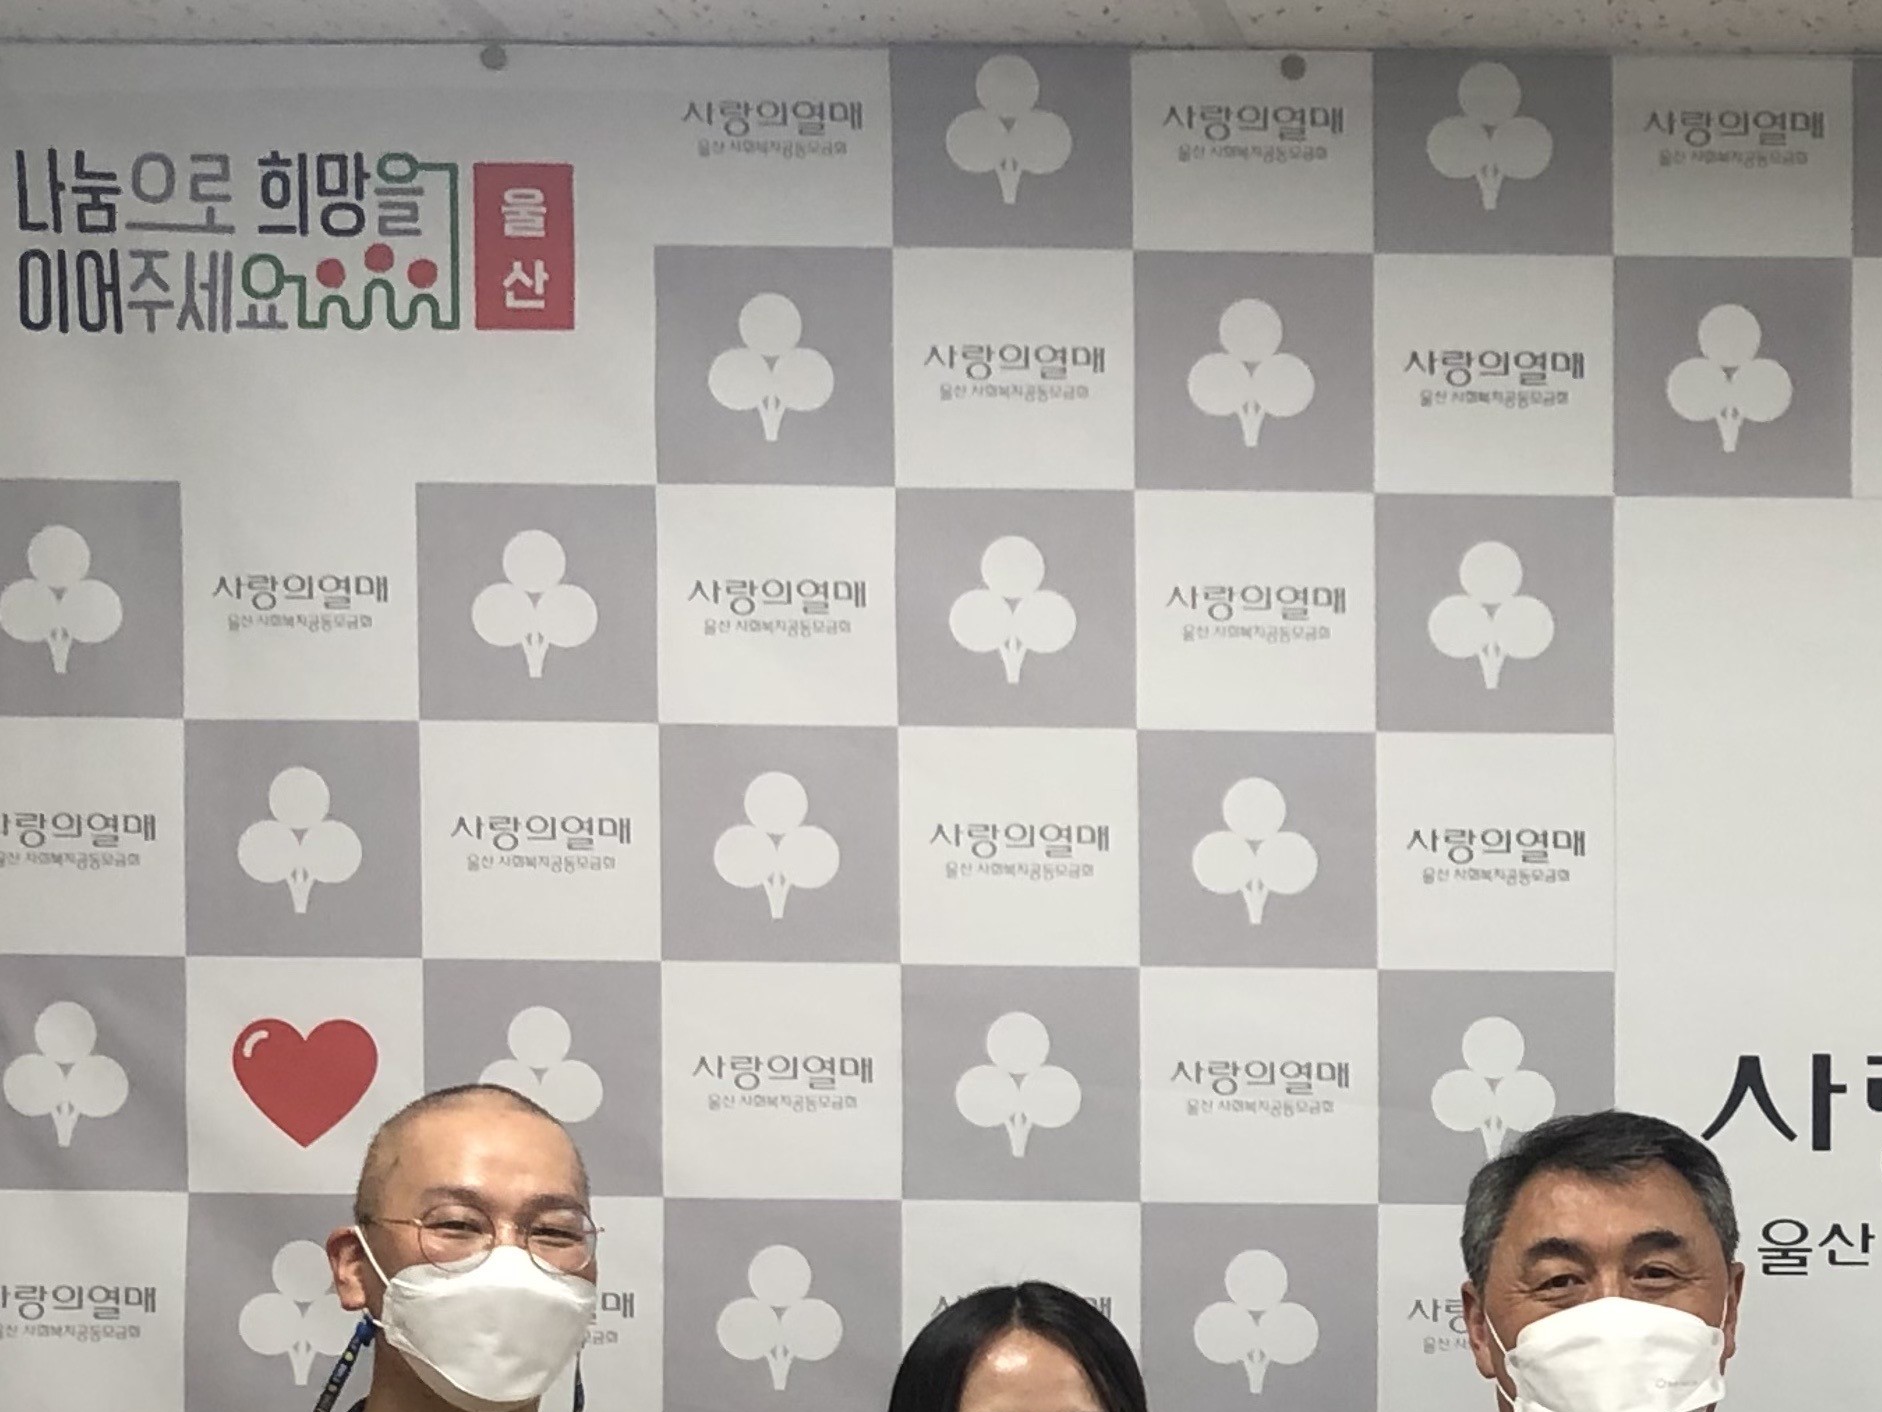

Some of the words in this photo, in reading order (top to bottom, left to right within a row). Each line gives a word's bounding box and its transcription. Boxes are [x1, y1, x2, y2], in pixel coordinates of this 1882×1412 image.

[682, 101, 862, 136] 사랑의열매
[1163, 106, 1343, 141] 사랑의열매
[1643, 112, 1823, 146] 사랑의열매
[15, 147, 235, 234] 나눔으로
[258, 150, 424, 237] 희망을
[502, 188, 549, 309] 울산
[19, 248, 288, 334] 이어주세요
[924, 344, 1105, 380] 사랑의열매
[1405, 350, 1584, 387] 사랑의열매
[213, 574, 388, 610] 사랑의열매
[688, 579, 866, 616] 사랑의열매
[1167, 585, 1346, 621] 사랑의열매
[451, 815, 631, 851] 사랑의열매
[930, 823, 1109, 859] 사랑의열매
[1407, 828, 1585, 865] 사랑의열매
[693, 1055, 873, 1091] 사랑의열매
[1171, 1060, 1349, 1096] 사랑의열매
[1757, 1219, 1875, 1276] 울산
